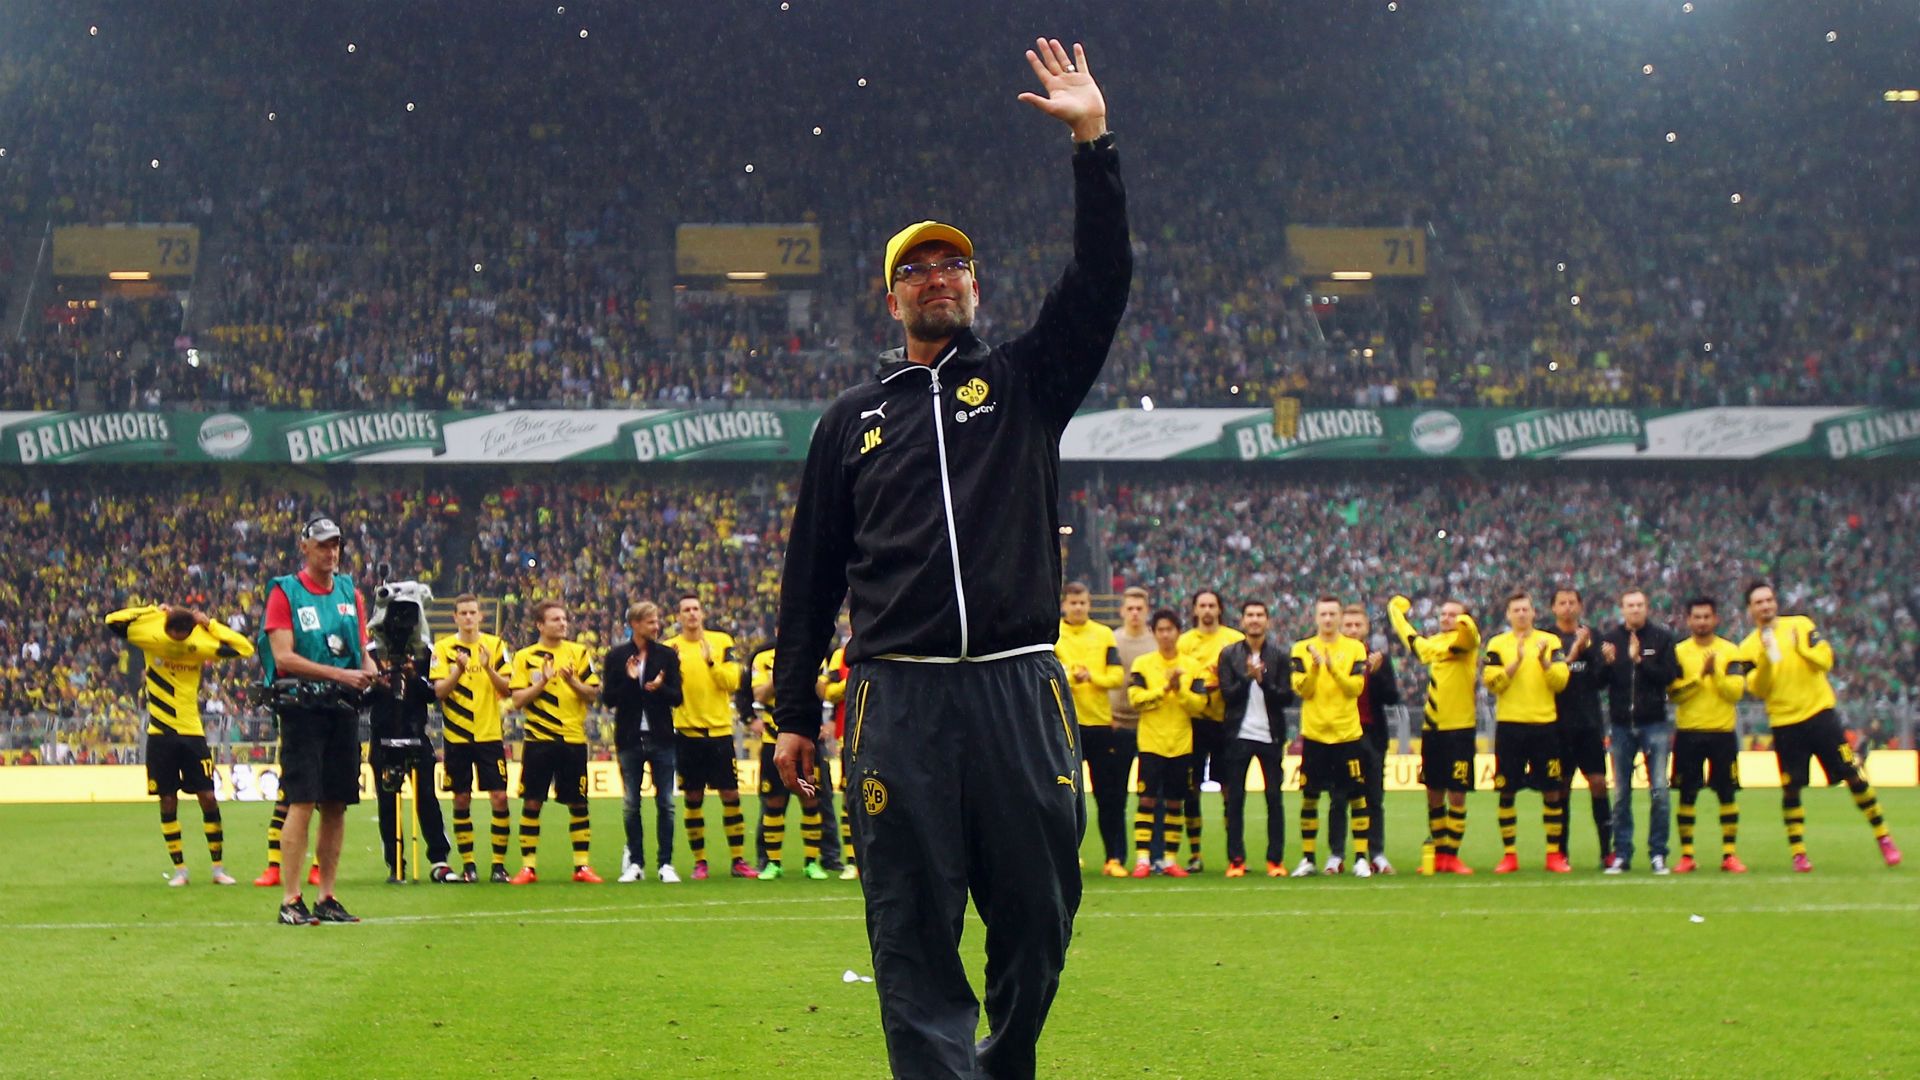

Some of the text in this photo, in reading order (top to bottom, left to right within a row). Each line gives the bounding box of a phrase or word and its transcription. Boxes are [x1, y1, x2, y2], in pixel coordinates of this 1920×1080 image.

[158, 238, 191, 265] 73
[777, 237, 812, 265] 72
[1384, 238, 1415, 265] 71
[861, 427, 882, 454] JK
[1348, 759, 1360, 777] 11
[864, 783, 883, 804] BVB
